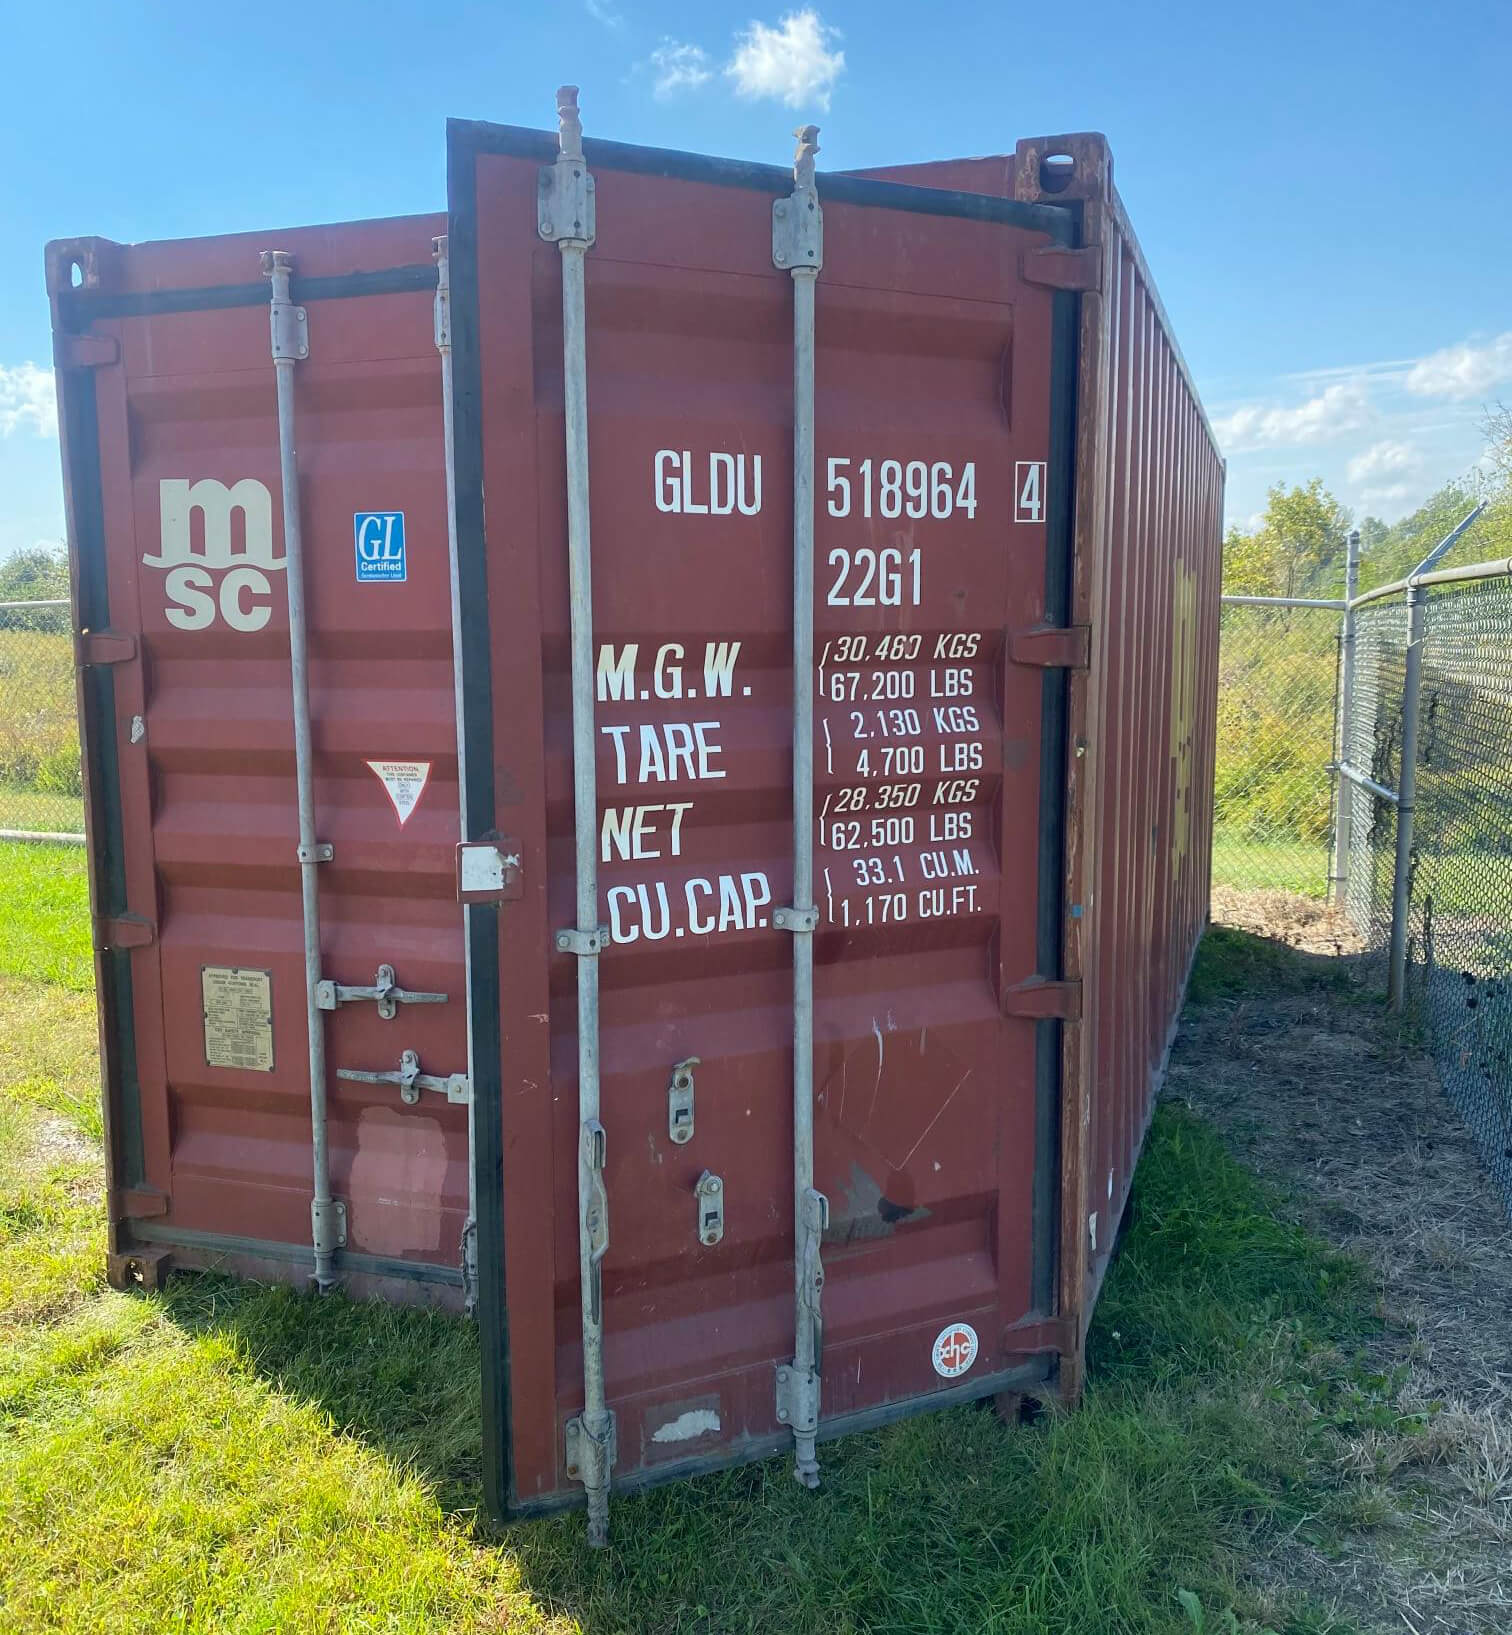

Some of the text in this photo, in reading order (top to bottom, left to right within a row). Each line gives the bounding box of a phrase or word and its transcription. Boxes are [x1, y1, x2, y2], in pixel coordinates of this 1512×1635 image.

[654, 449, 1041, 519] GLDU 518964 4
[358, 516, 402, 560] GL
[361, 561, 402, 572] Certified
[827, 548, 922, 606] 22G1
[933, 633, 982, 659] KGS
[596, 642, 752, 701] M.G.W.
[831, 668, 973, 702] 67,200 LBS
[850, 706, 980, 738] 2,130 KGS
[601, 721, 727, 784] TARE
[856, 742, 983, 778] 4,700 LBS
[834, 779, 980, 813] 28,350 KGS
[601, 802, 694, 862] NET
[832, 812, 972, 850] 62,500 LBS
[853, 849, 980, 887] 33.1 CU.M.
[607, 872, 771, 944] CU.CAP.
[841, 885, 982, 927] 1,170 CU.FT.
